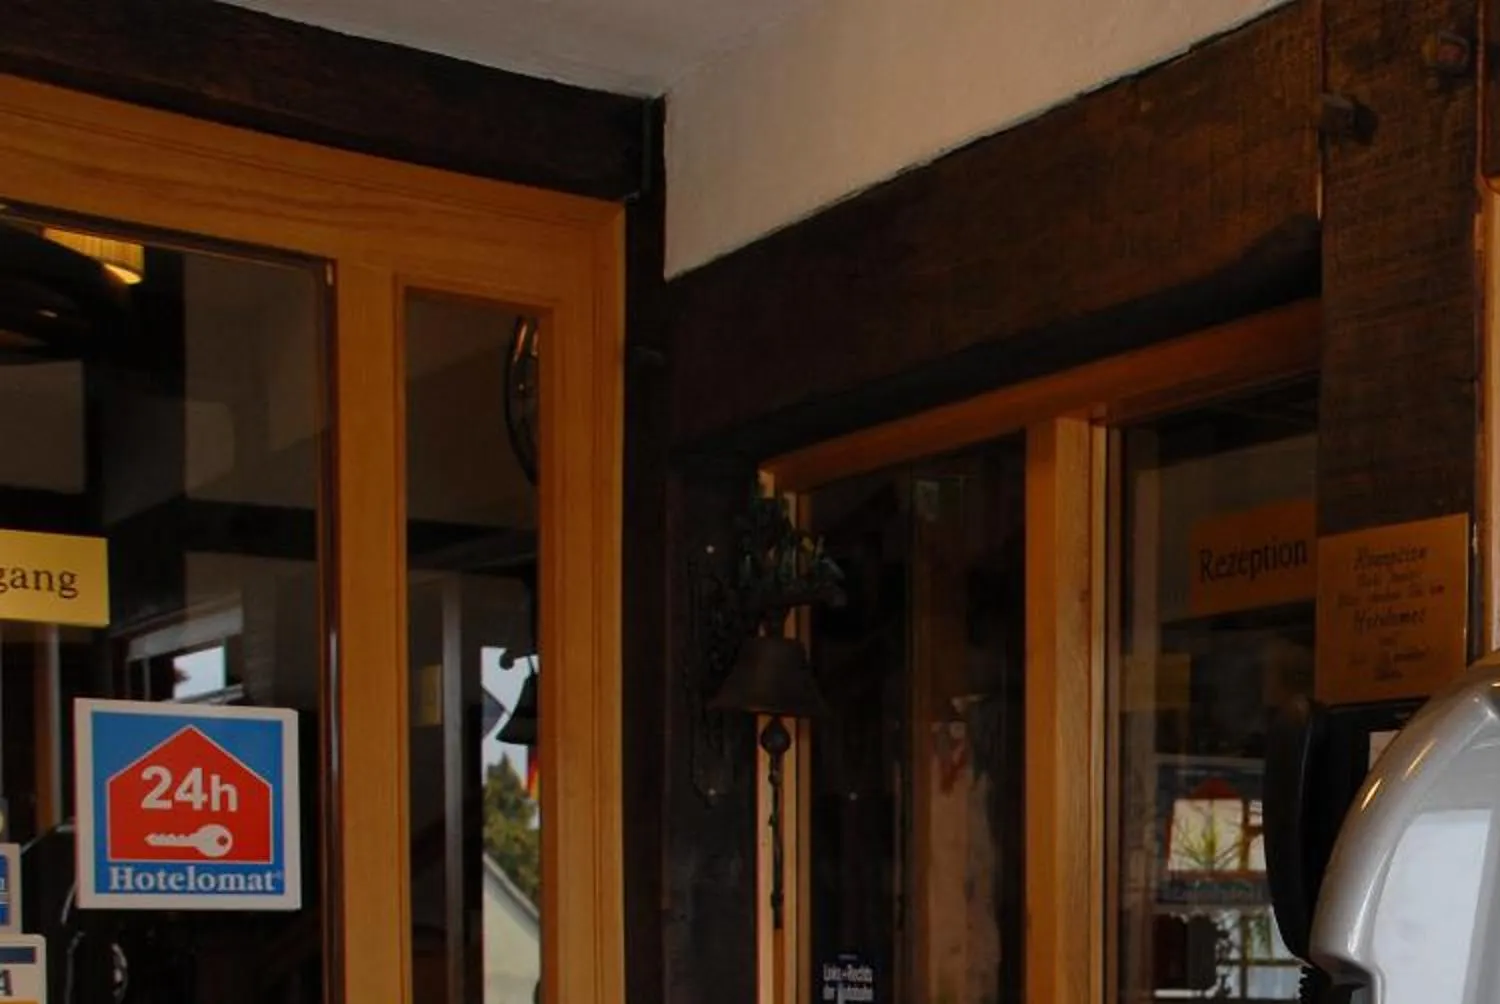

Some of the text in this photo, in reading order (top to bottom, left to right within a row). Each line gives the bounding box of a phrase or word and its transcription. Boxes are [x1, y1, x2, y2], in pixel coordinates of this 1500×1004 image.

[1198, 534, 1308, 584] Rezeption
[140, 764, 239, 813] 24h
[108, 865, 276, 892] Hotelomat
